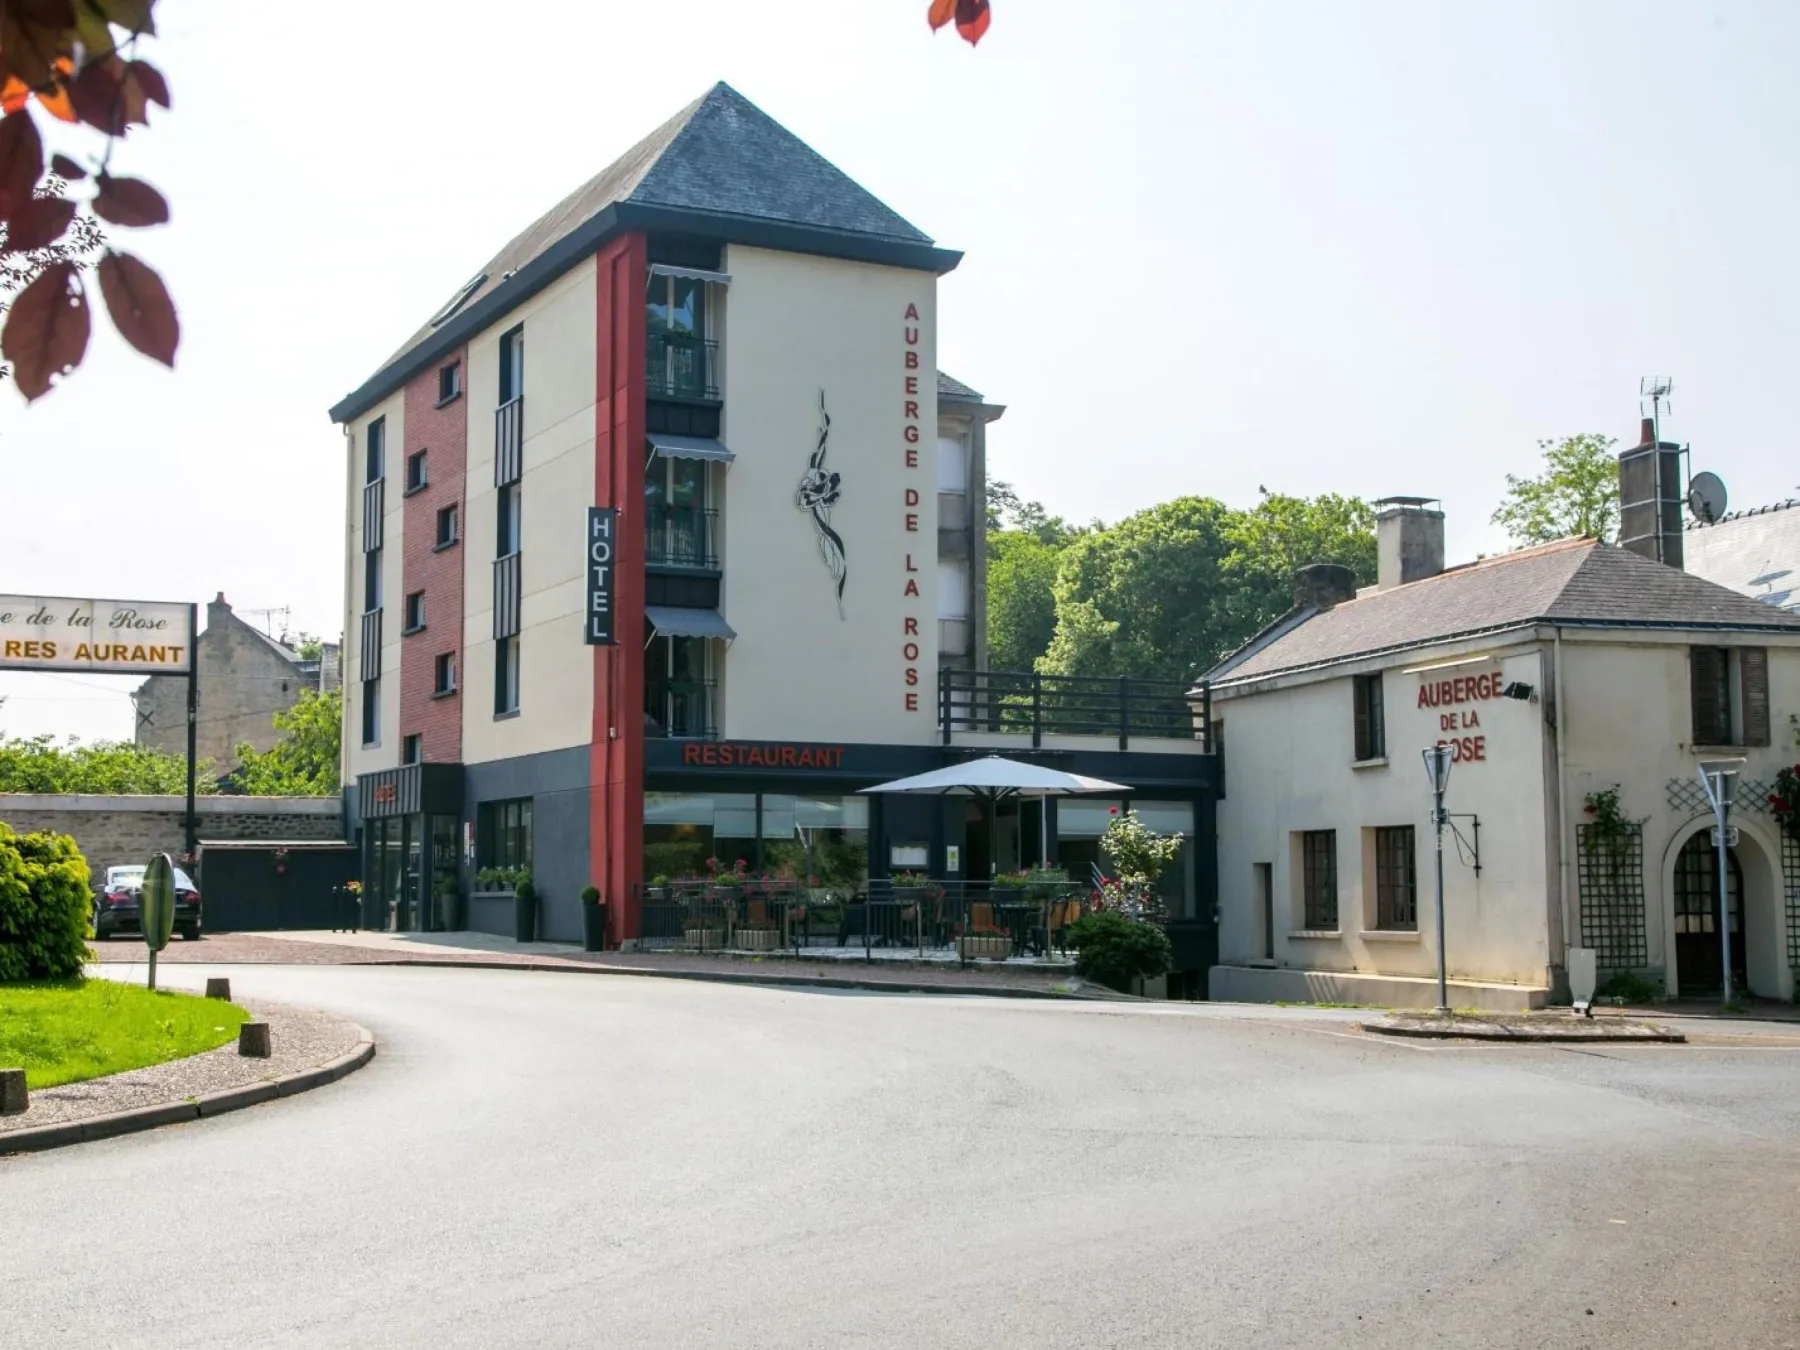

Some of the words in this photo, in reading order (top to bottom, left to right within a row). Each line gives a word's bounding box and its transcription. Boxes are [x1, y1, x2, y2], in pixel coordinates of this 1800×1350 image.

[904, 302, 919, 468] AUBERGE
[905, 488, 919, 532] DE
[591, 516, 610, 638] HOTEL
[904, 553, 919, 597] LA
[0, 610, 14, 624] e
[26, 606, 56, 626] de
[67, 607, 94, 628] la
[108, 608, 168, 631] Rose
[903, 616, 919, 712] ROSE
[1417, 672, 1503, 708] AUBERGE
[1440, 712, 1458, 731] DE
[1461, 709, 1480, 729] LA
[684, 743, 844, 768] RESTAURANT
